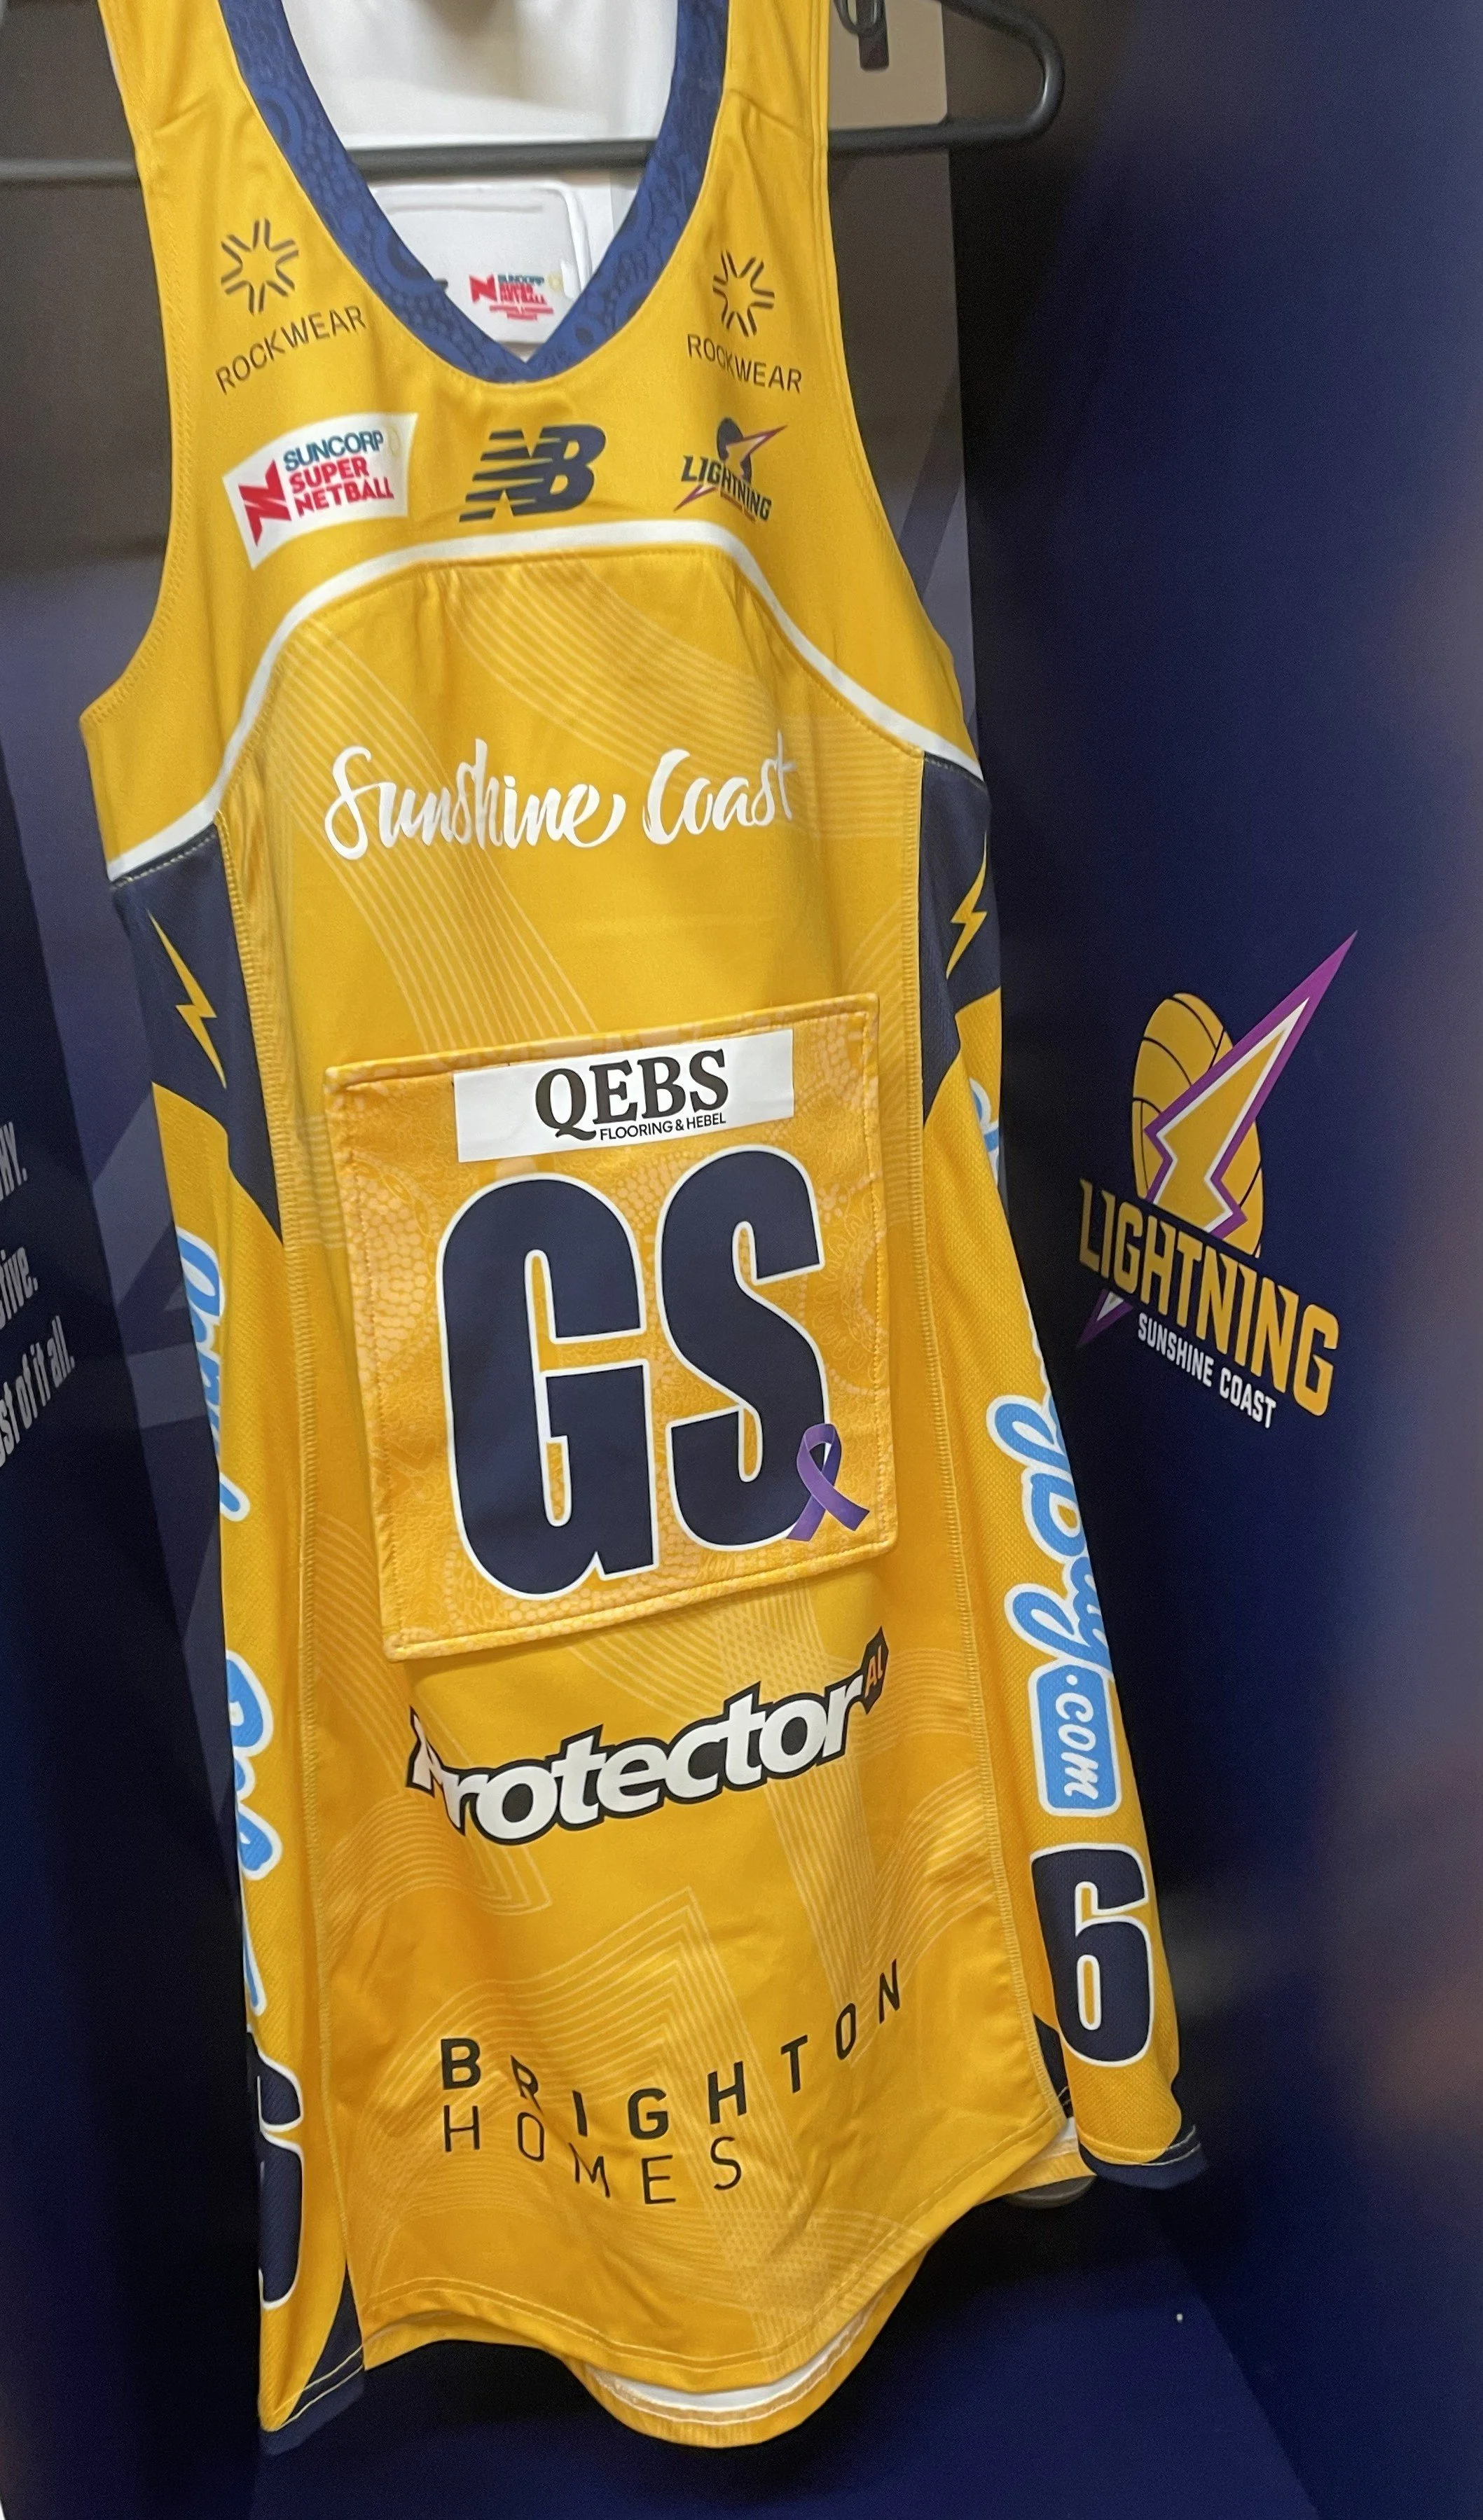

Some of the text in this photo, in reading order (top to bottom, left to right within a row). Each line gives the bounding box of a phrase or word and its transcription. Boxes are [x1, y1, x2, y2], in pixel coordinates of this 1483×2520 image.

[214, 305, 368, 396] ROCKWEAR
[687, 333, 802, 394] ROCKWEAR
[282, 429, 384, 472] SUNCORP
[289, 456, 369, 491] SUPER
[291, 476, 395, 518] NETBALL
[459, 424, 607, 522] NB
[680, 455, 772, 522] LIGHTNING
[324, 728, 797, 861] Sunshine Coast
[534, 1048, 729, 1142] QEBS
[600, 1112, 726, 1142] FLOORING & HEBEL
[1078, 1177, 1339, 1417] LIGHTNING
[0, 1315, 75, 1467] st of it all.
[436, 1144, 832, 1602] GS
[1138, 1312, 1277, 1429] SUNSHINE COAST
[1030, 1842, 1154, 2068] 6
[441, 1958, 902, 2140] BRIGHTON
[442, 2104, 742, 2205] HOMES
